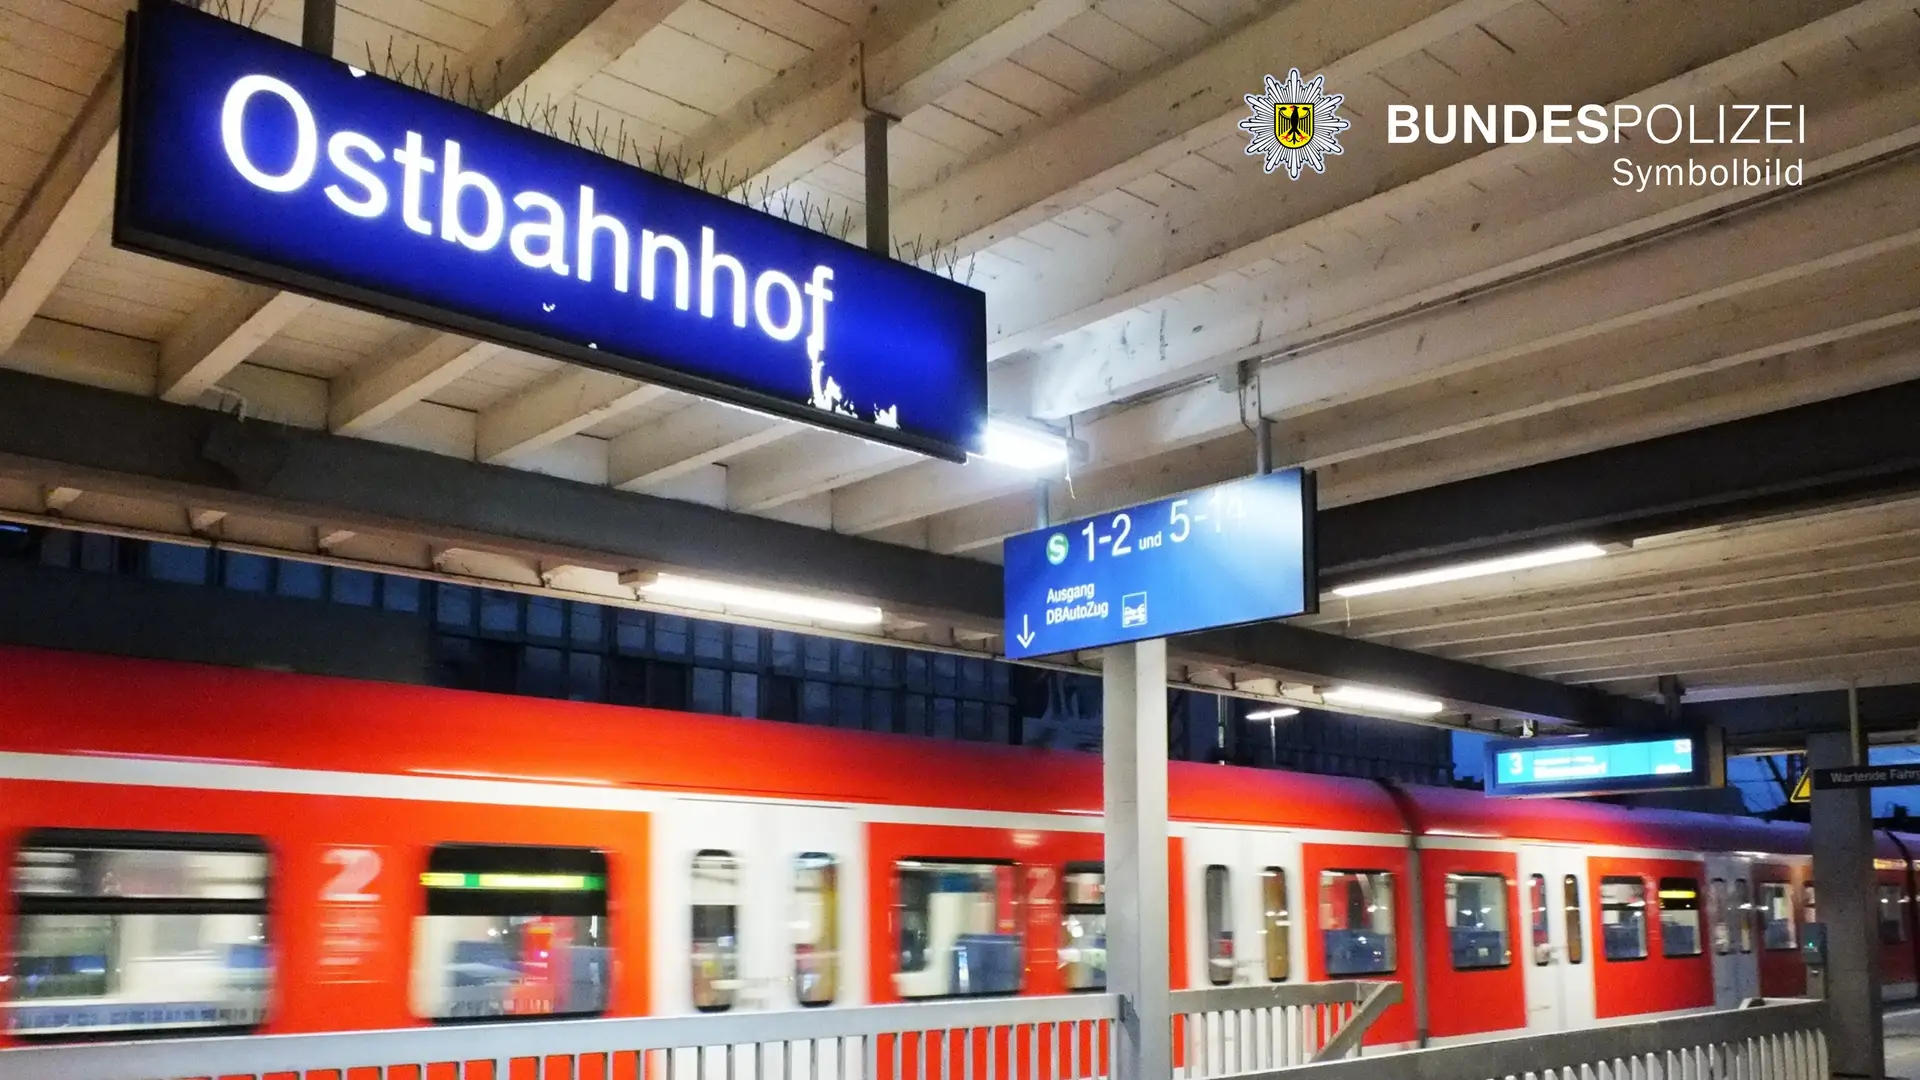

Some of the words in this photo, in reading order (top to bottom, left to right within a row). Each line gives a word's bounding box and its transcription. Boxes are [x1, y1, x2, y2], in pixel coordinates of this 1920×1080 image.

[220, 73, 836, 345] Ostbahnhof
[1081, 512, 1132, 562] 1-2
[1138, 530, 1162, 551] und
[1046, 582, 1095, 605] Ausgang
[1046, 599, 1109, 626] DBAutoZug
[1509, 752, 1523, 775] 3
[1830, 770, 1887, 783] Wartende
[321, 848, 383, 901] 2
